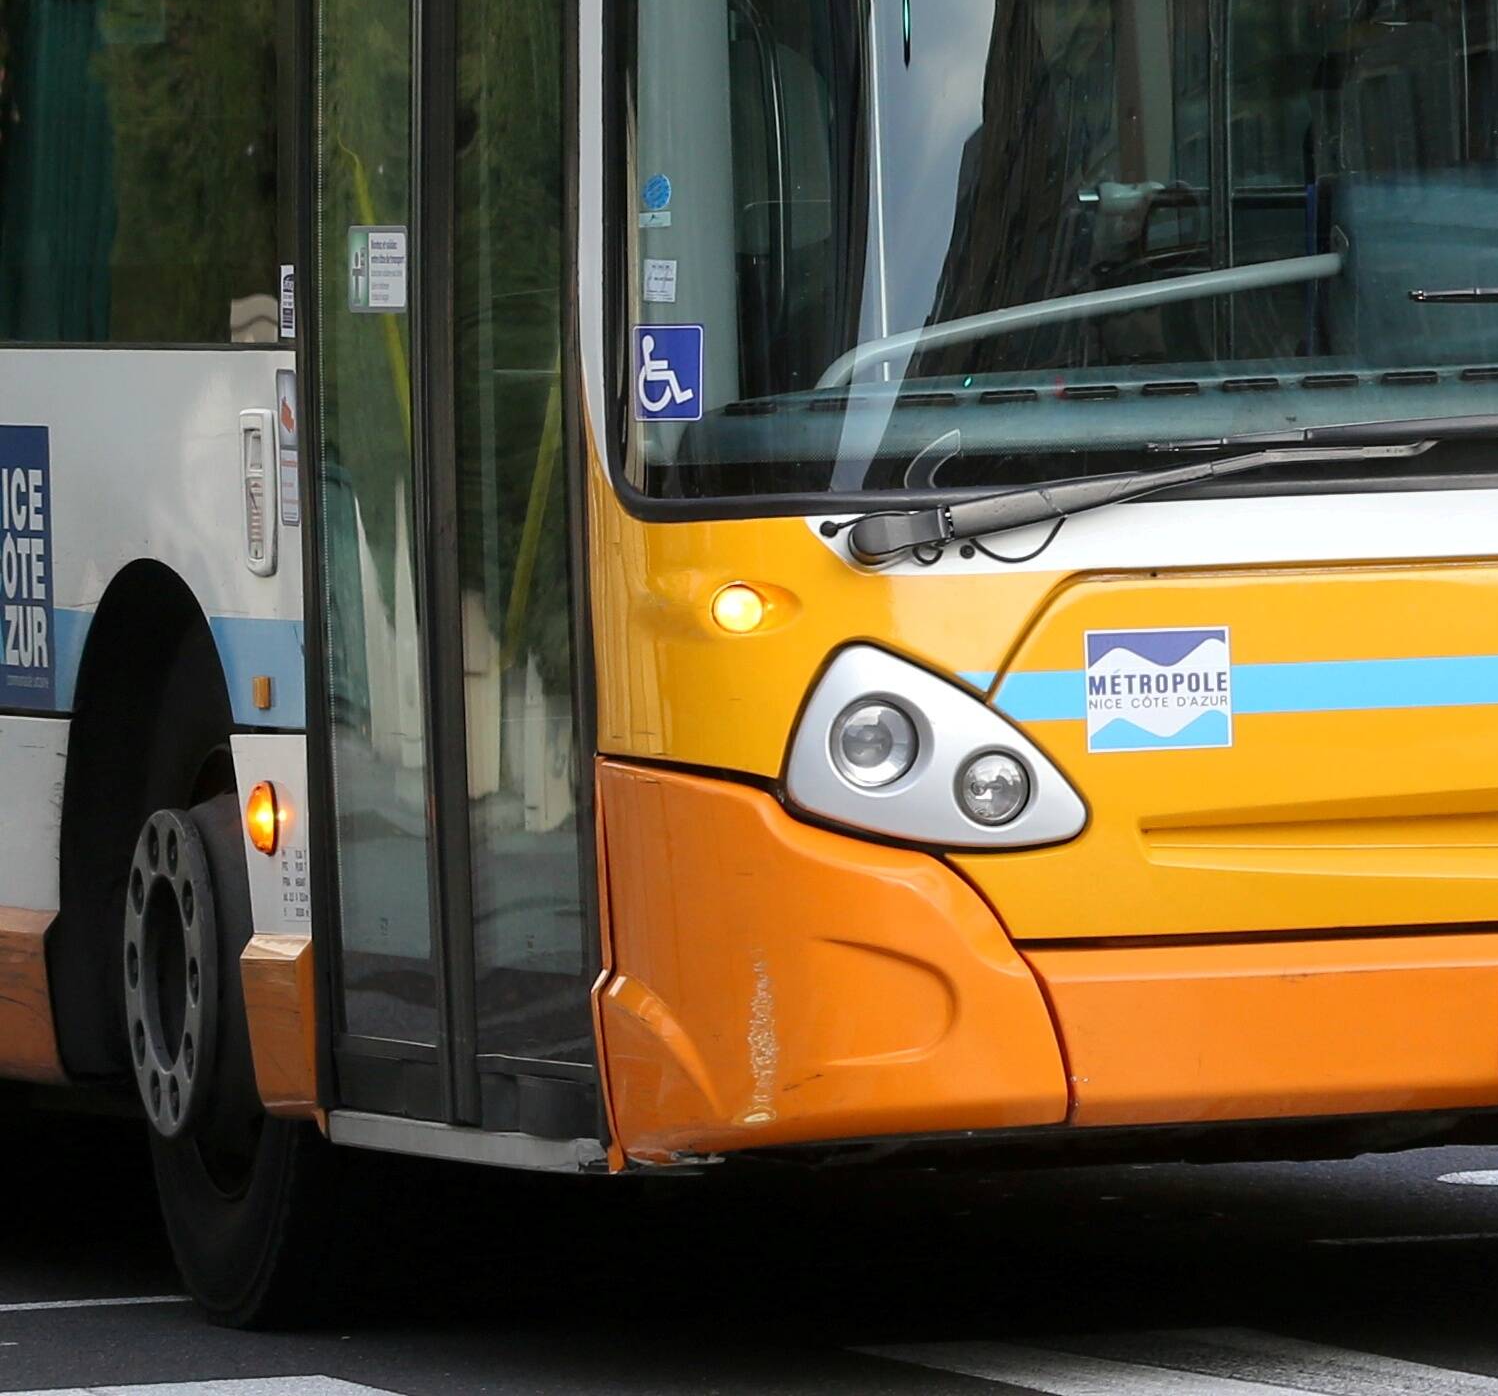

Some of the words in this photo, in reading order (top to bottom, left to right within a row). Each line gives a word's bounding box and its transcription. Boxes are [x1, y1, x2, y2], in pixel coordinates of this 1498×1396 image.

[1088, 669, 1227, 696] MÉTROPOLE
[1089, 699, 1122, 710] NICE
[1131, 696, 1168, 708] CÔTE
[1177, 695, 1228, 707] D'AZUR
